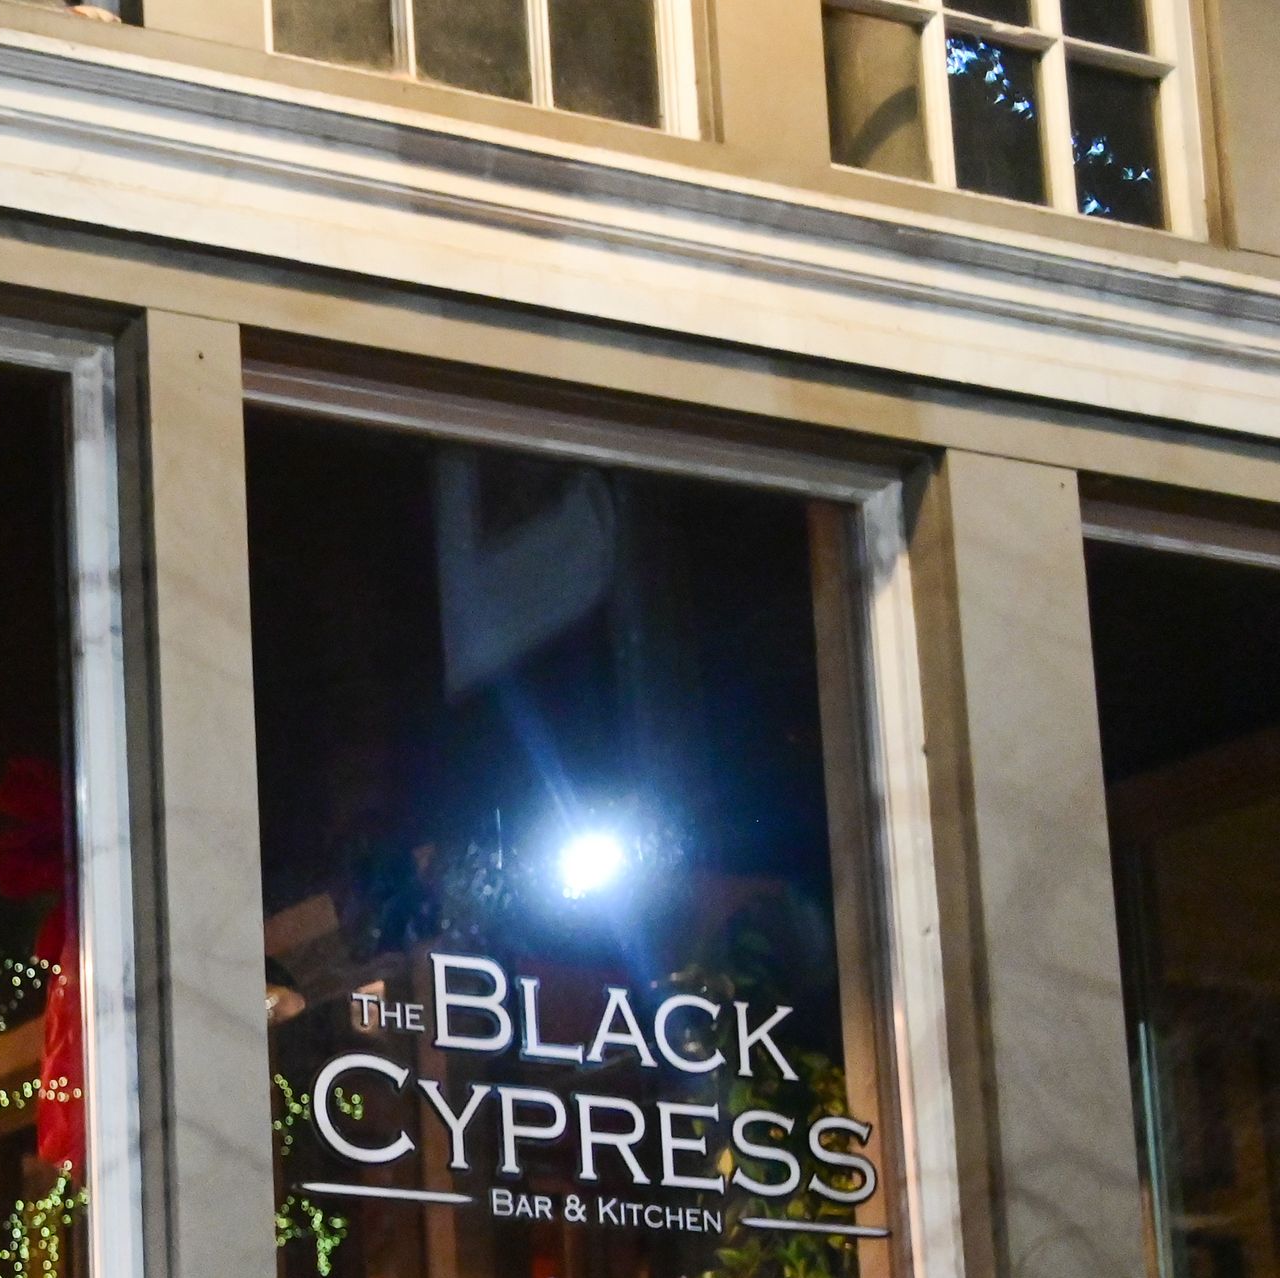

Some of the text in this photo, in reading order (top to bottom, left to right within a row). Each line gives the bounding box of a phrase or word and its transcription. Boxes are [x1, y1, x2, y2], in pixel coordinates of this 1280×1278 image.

[351, 952, 800, 1081] THE BLACK
[312, 1053, 878, 1202] CYPRESS
[492, 1188, 724, 1235] BAR & KITCHEN
